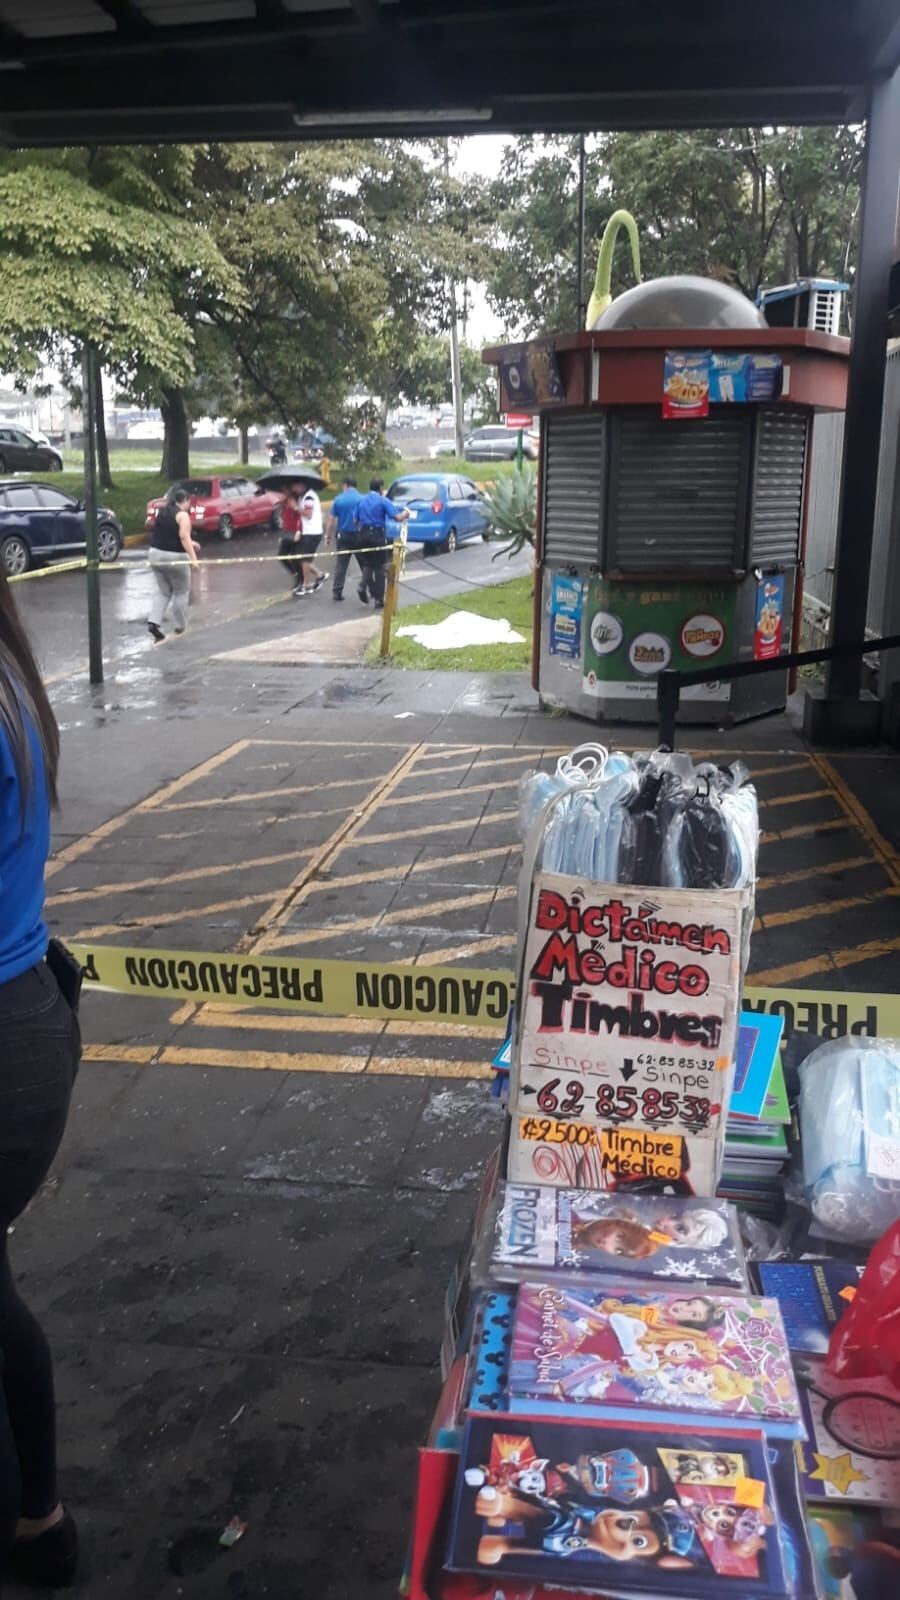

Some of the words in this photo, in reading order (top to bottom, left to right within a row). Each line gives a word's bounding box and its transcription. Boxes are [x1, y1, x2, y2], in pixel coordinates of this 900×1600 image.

[125, 956, 323, 1003] PRECAUCION
[531, 982, 723, 1049] Timbres
[535, 1047, 607, 1077] Sinpe
[642, 1066, 710, 1092] Sinpe
[601, 1128, 675, 1156] Timbre
[601, 1152, 678, 1179] Médico
[505, 1186, 541, 1257] FROZEN
[540, 1329, 562, 1346] de
[534, 1347, 563, 1383] Salud
